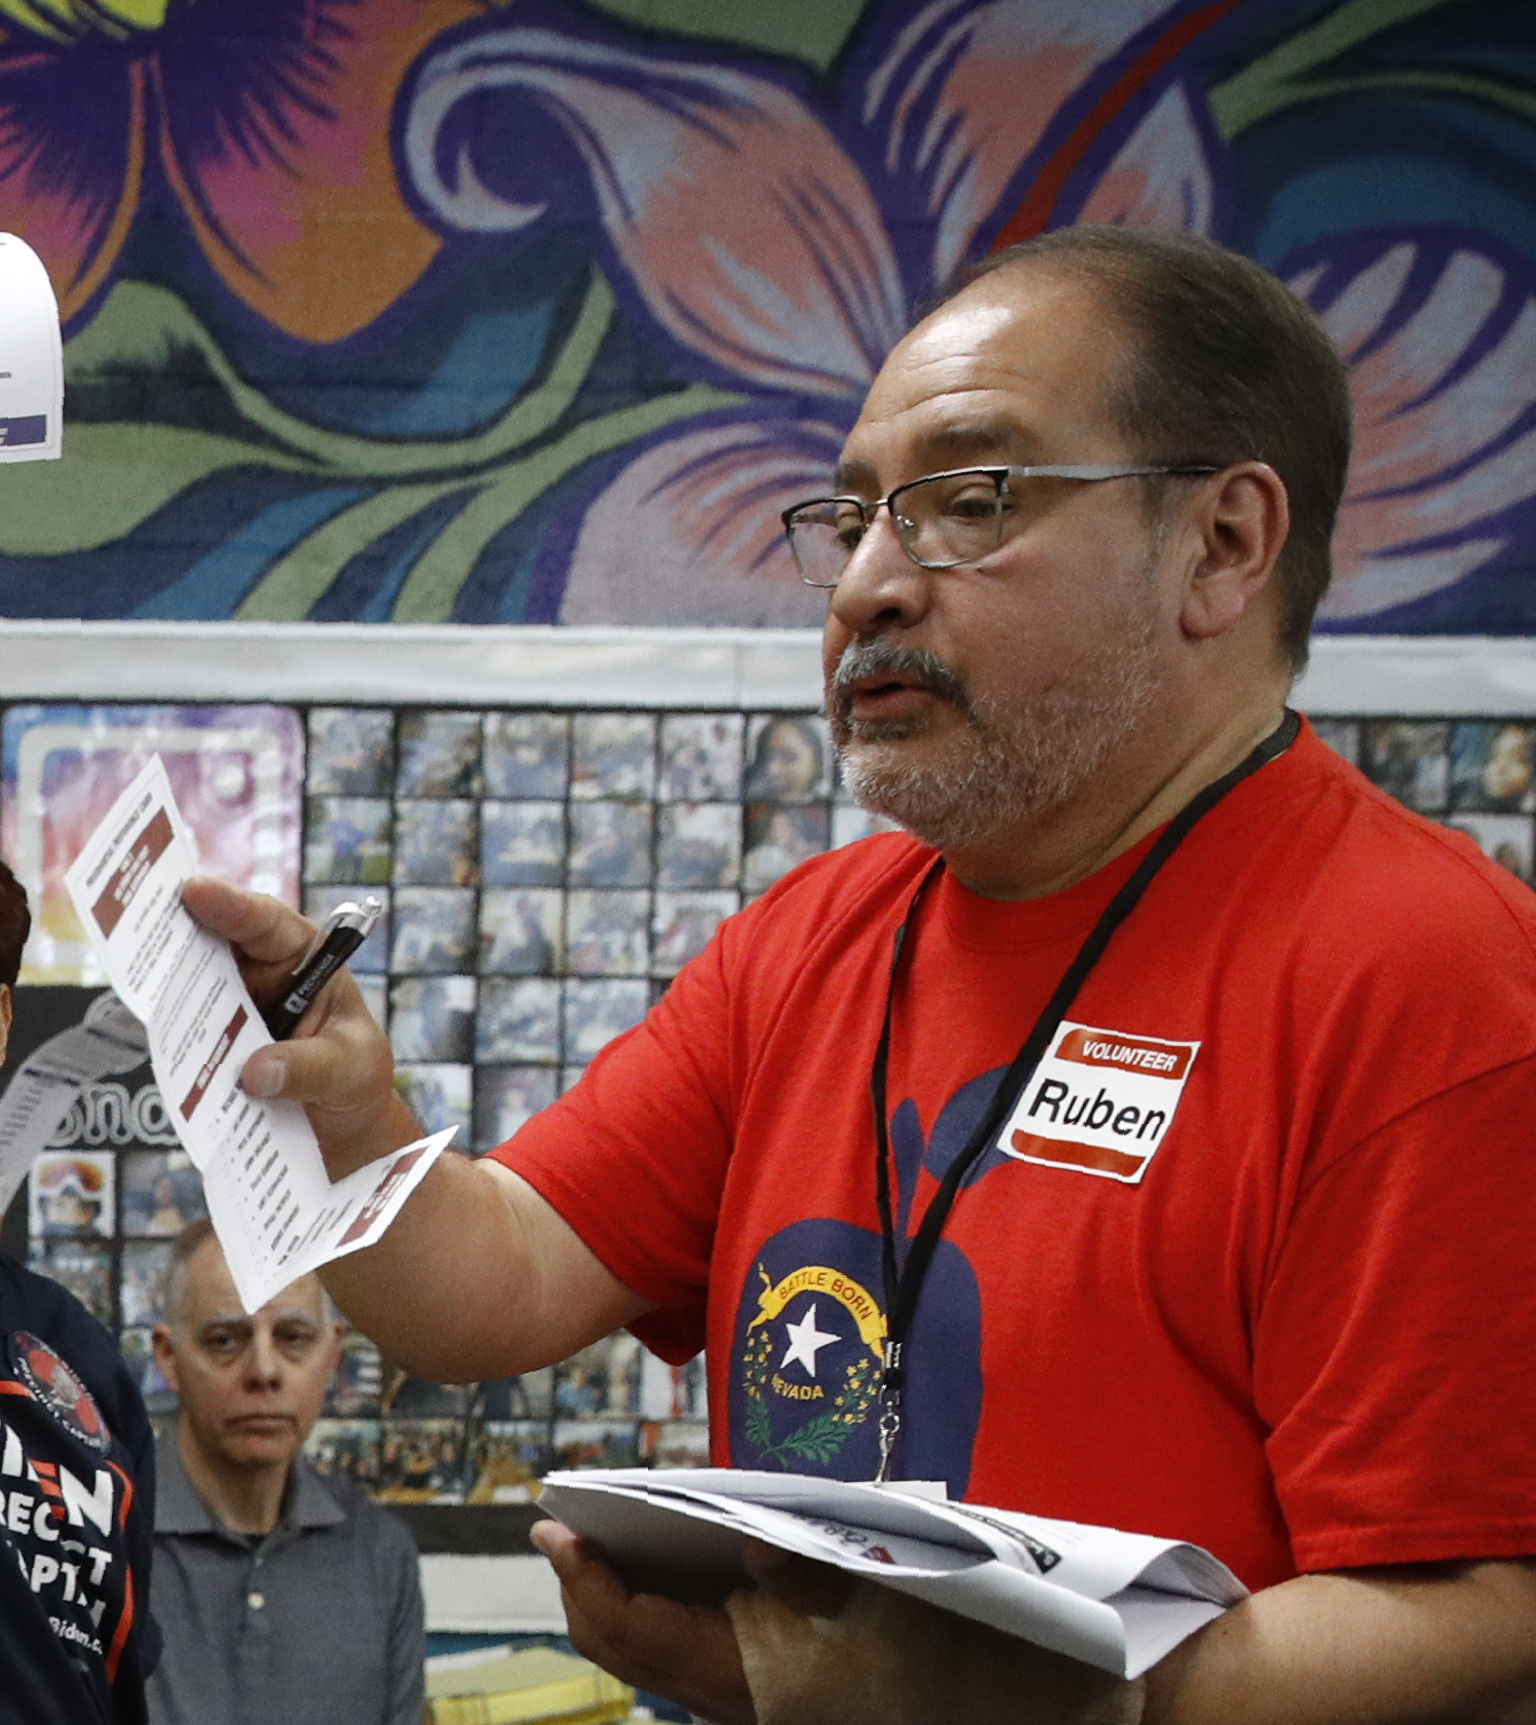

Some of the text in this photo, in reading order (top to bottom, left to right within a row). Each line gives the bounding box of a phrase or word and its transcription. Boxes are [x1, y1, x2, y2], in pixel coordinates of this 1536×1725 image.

[1081, 1038, 1178, 1073] VOLUNTEER
[1027, 1077, 1166, 1142] Ruben
[778, 1271, 872, 1322] BATTLE BORN
[770, 1373, 826, 1402] NEVADA
